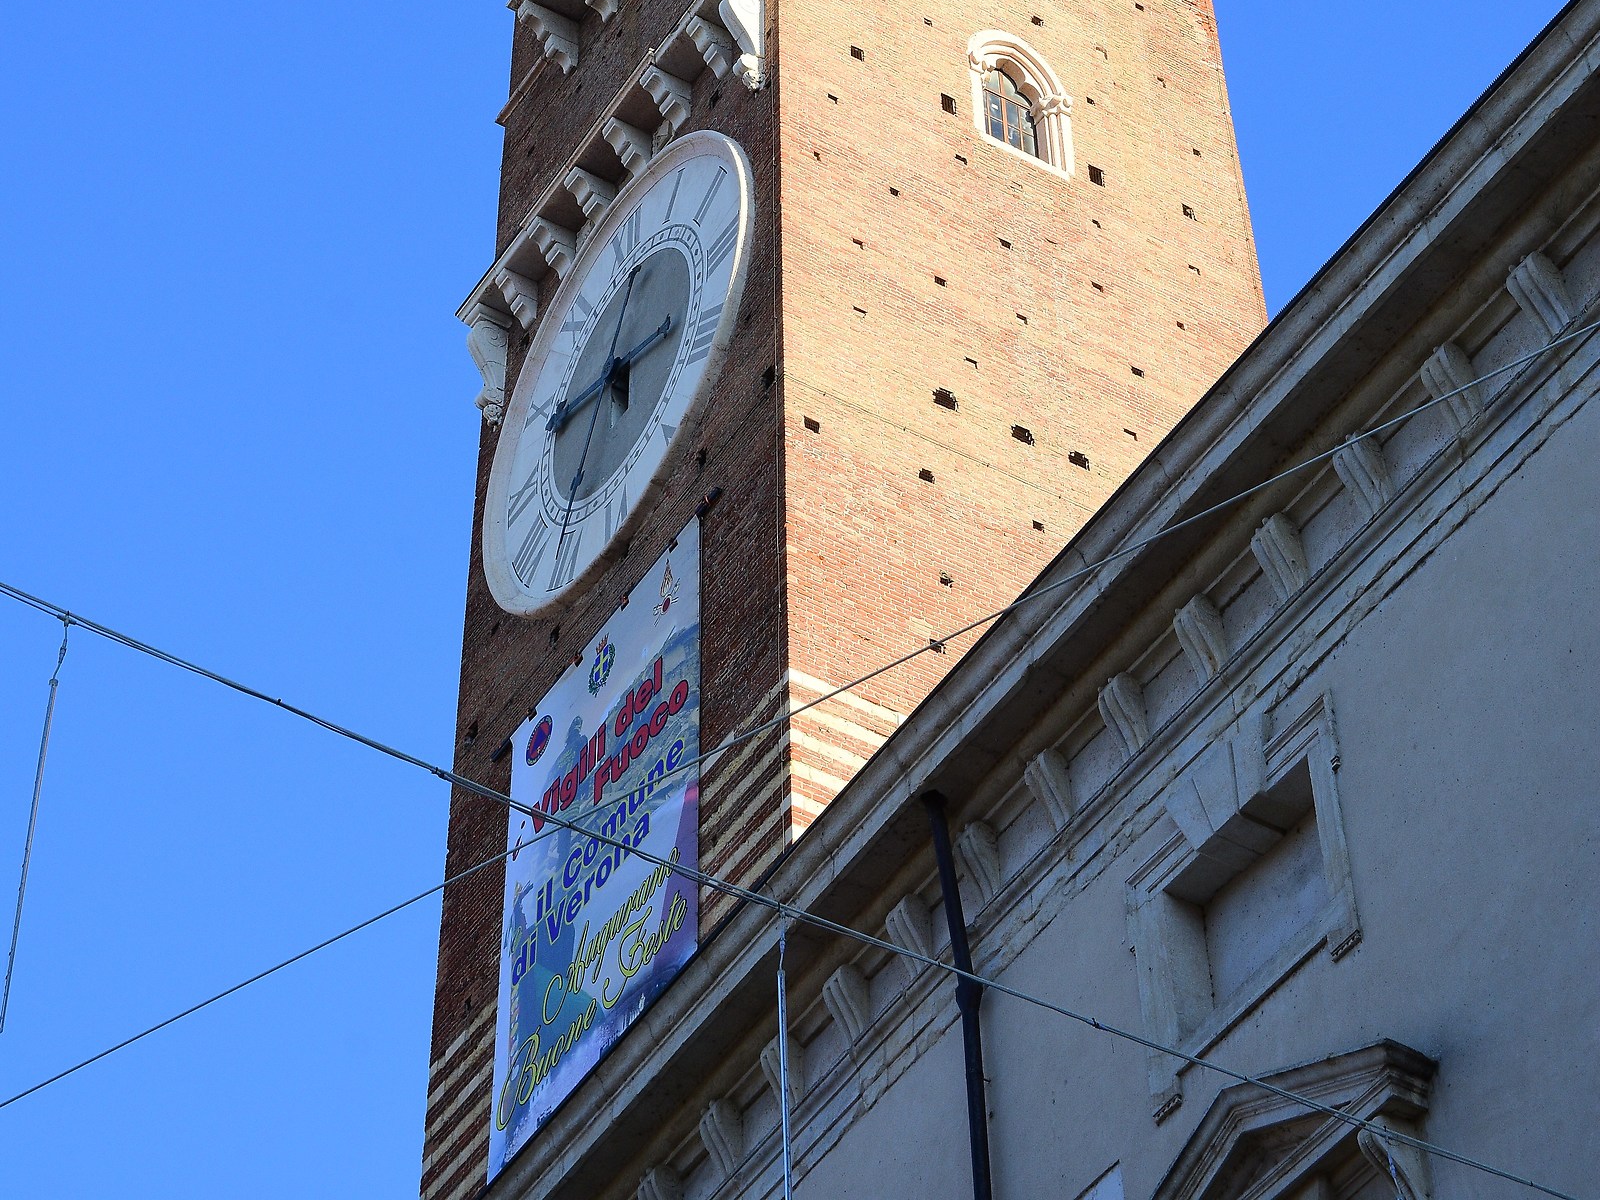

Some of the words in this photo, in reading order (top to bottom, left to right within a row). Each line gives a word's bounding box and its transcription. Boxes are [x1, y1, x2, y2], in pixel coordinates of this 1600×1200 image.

[531, 723, 606, 834] Vigili
[614, 657, 663, 737] del
[536, 877, 553, 923] il
[562, 737, 685, 889] Comune
[593, 679, 689, 806] Fuoco
[511, 930, 538, 988] di
[547, 810, 651, 944] Verona
[542, 846, 681, 1025] Augurano
[496, 997, 597, 1131] Buone
[602, 889, 687, 1009] Feste
